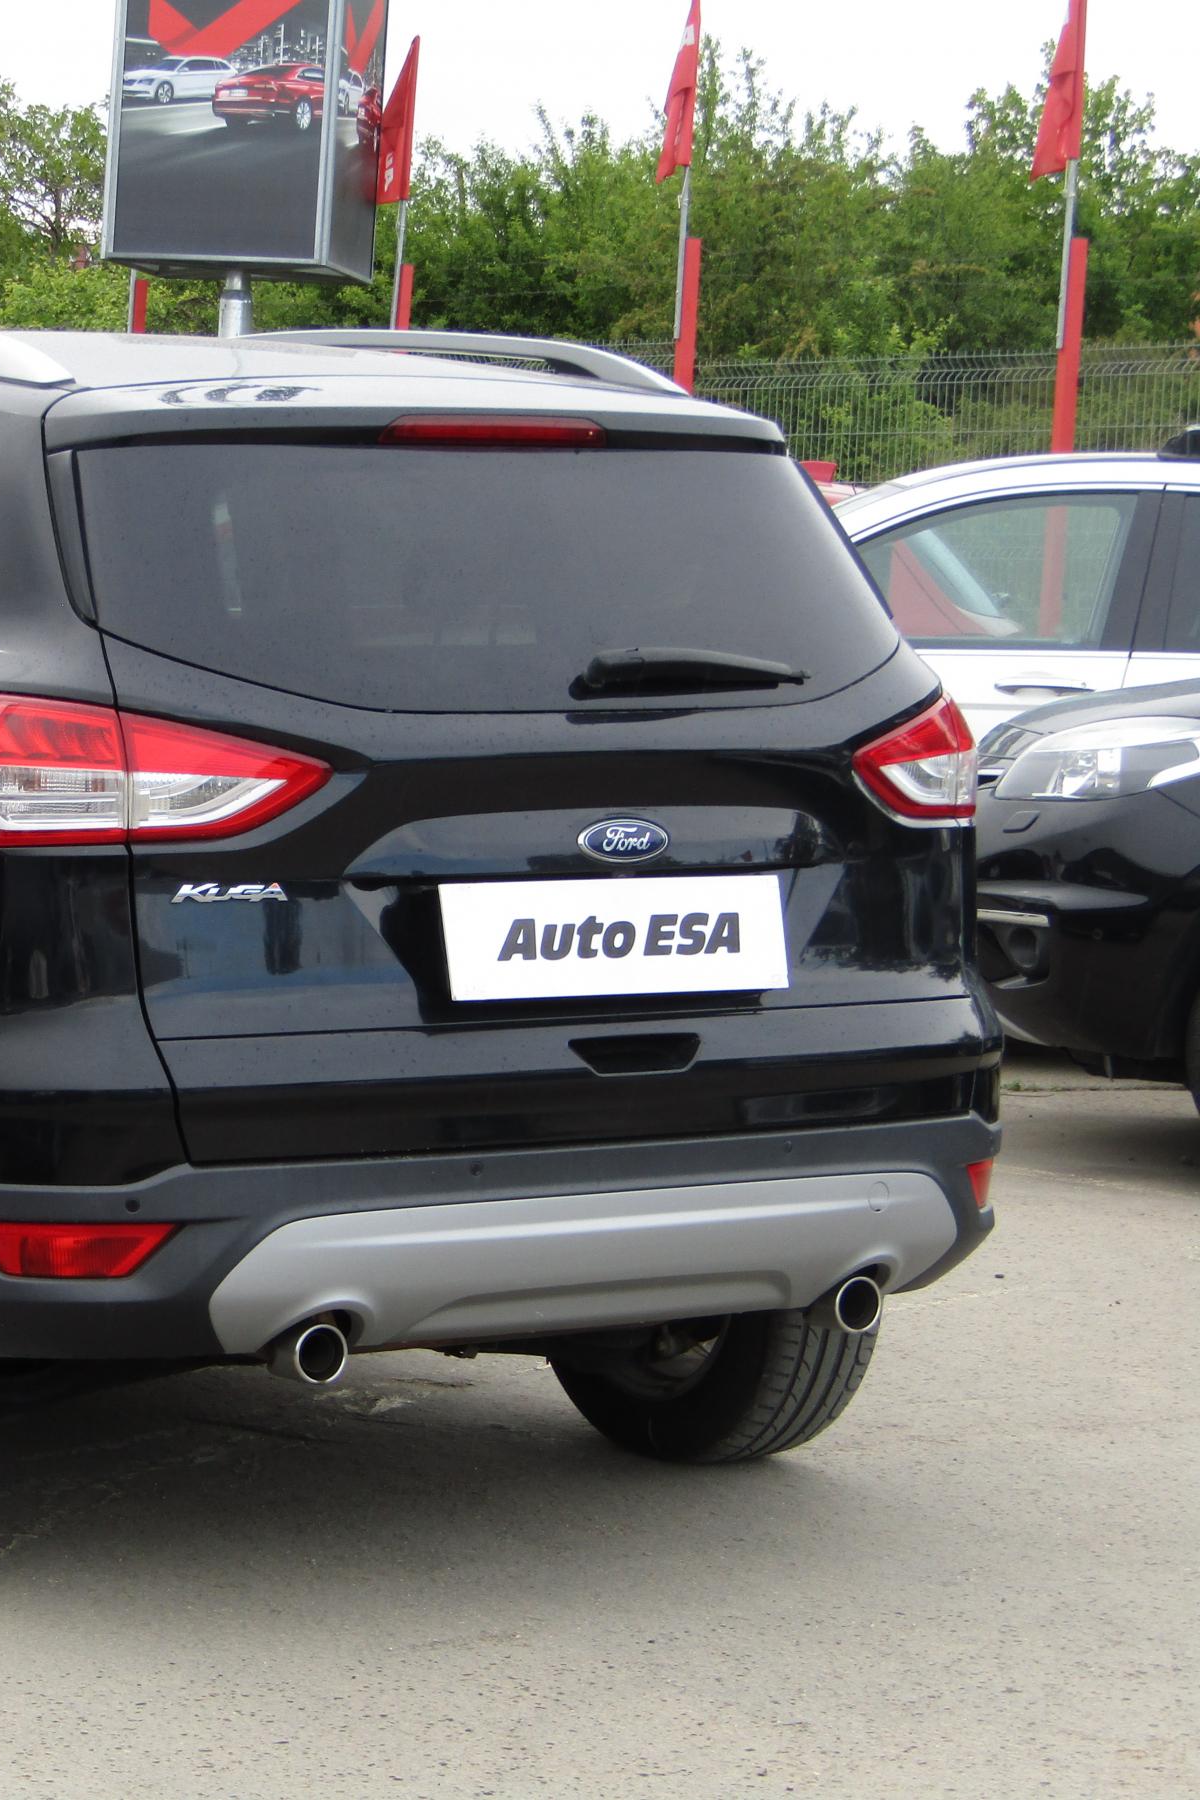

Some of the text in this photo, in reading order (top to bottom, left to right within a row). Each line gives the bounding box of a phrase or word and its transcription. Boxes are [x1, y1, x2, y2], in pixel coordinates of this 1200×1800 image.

[603, 826, 650, 852] Ford
[171, 882, 288, 903] KUGA
[497, 912, 741, 961] Auto ESA
